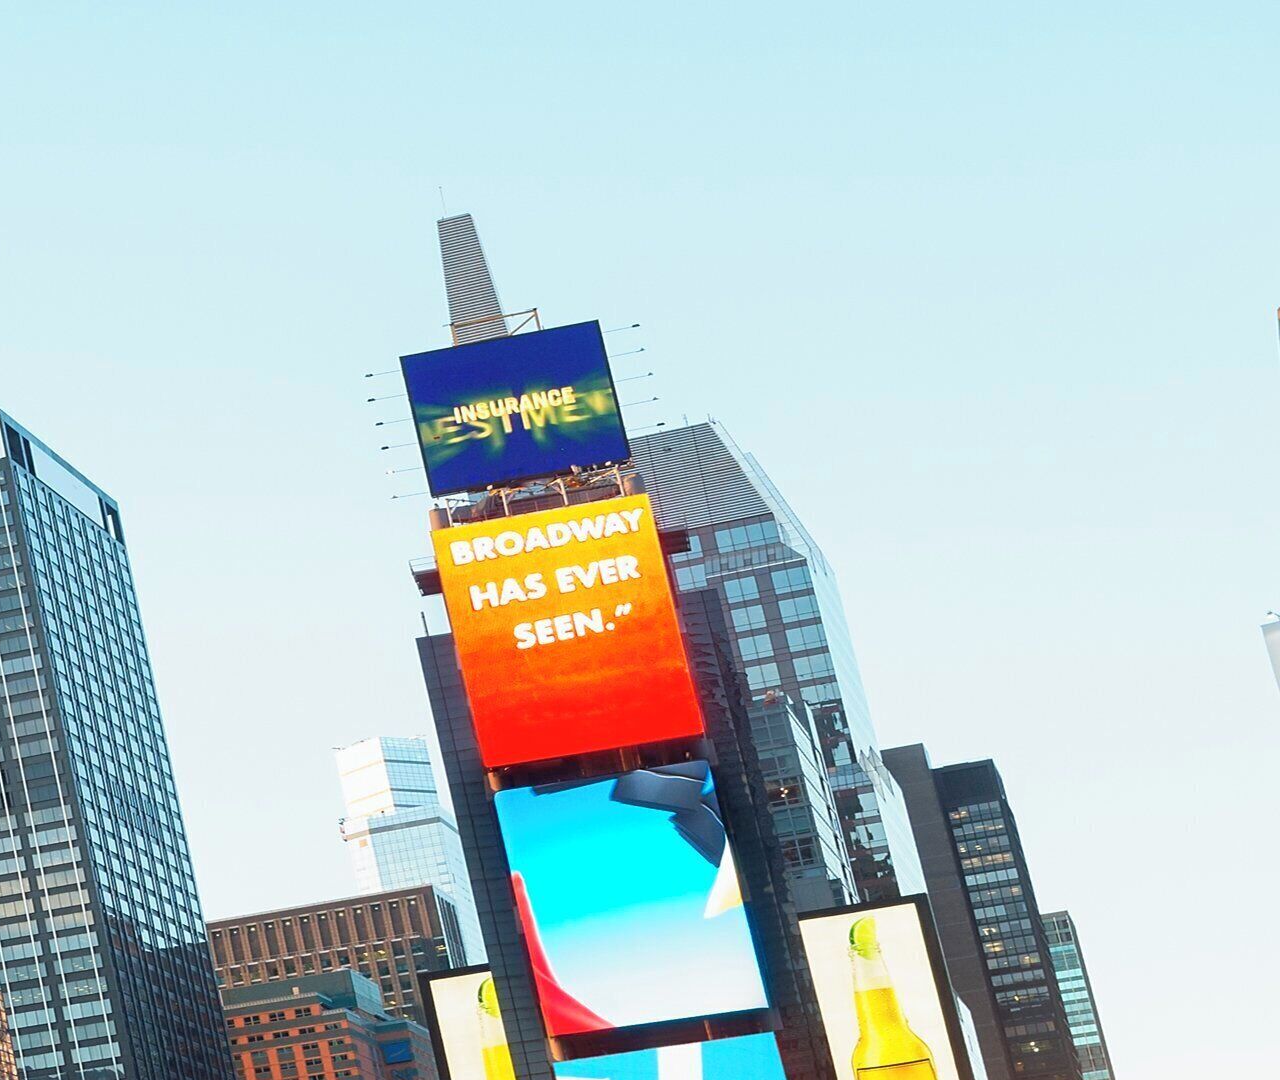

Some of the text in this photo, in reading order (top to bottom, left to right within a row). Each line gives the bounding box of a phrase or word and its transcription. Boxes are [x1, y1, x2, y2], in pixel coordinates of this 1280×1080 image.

[453, 386, 577, 424] INSURANCE
[450, 508, 644, 568] BROADWAY
[468, 554, 642, 611] HAS EVER
[513, 603, 633, 650] SEEN.”
